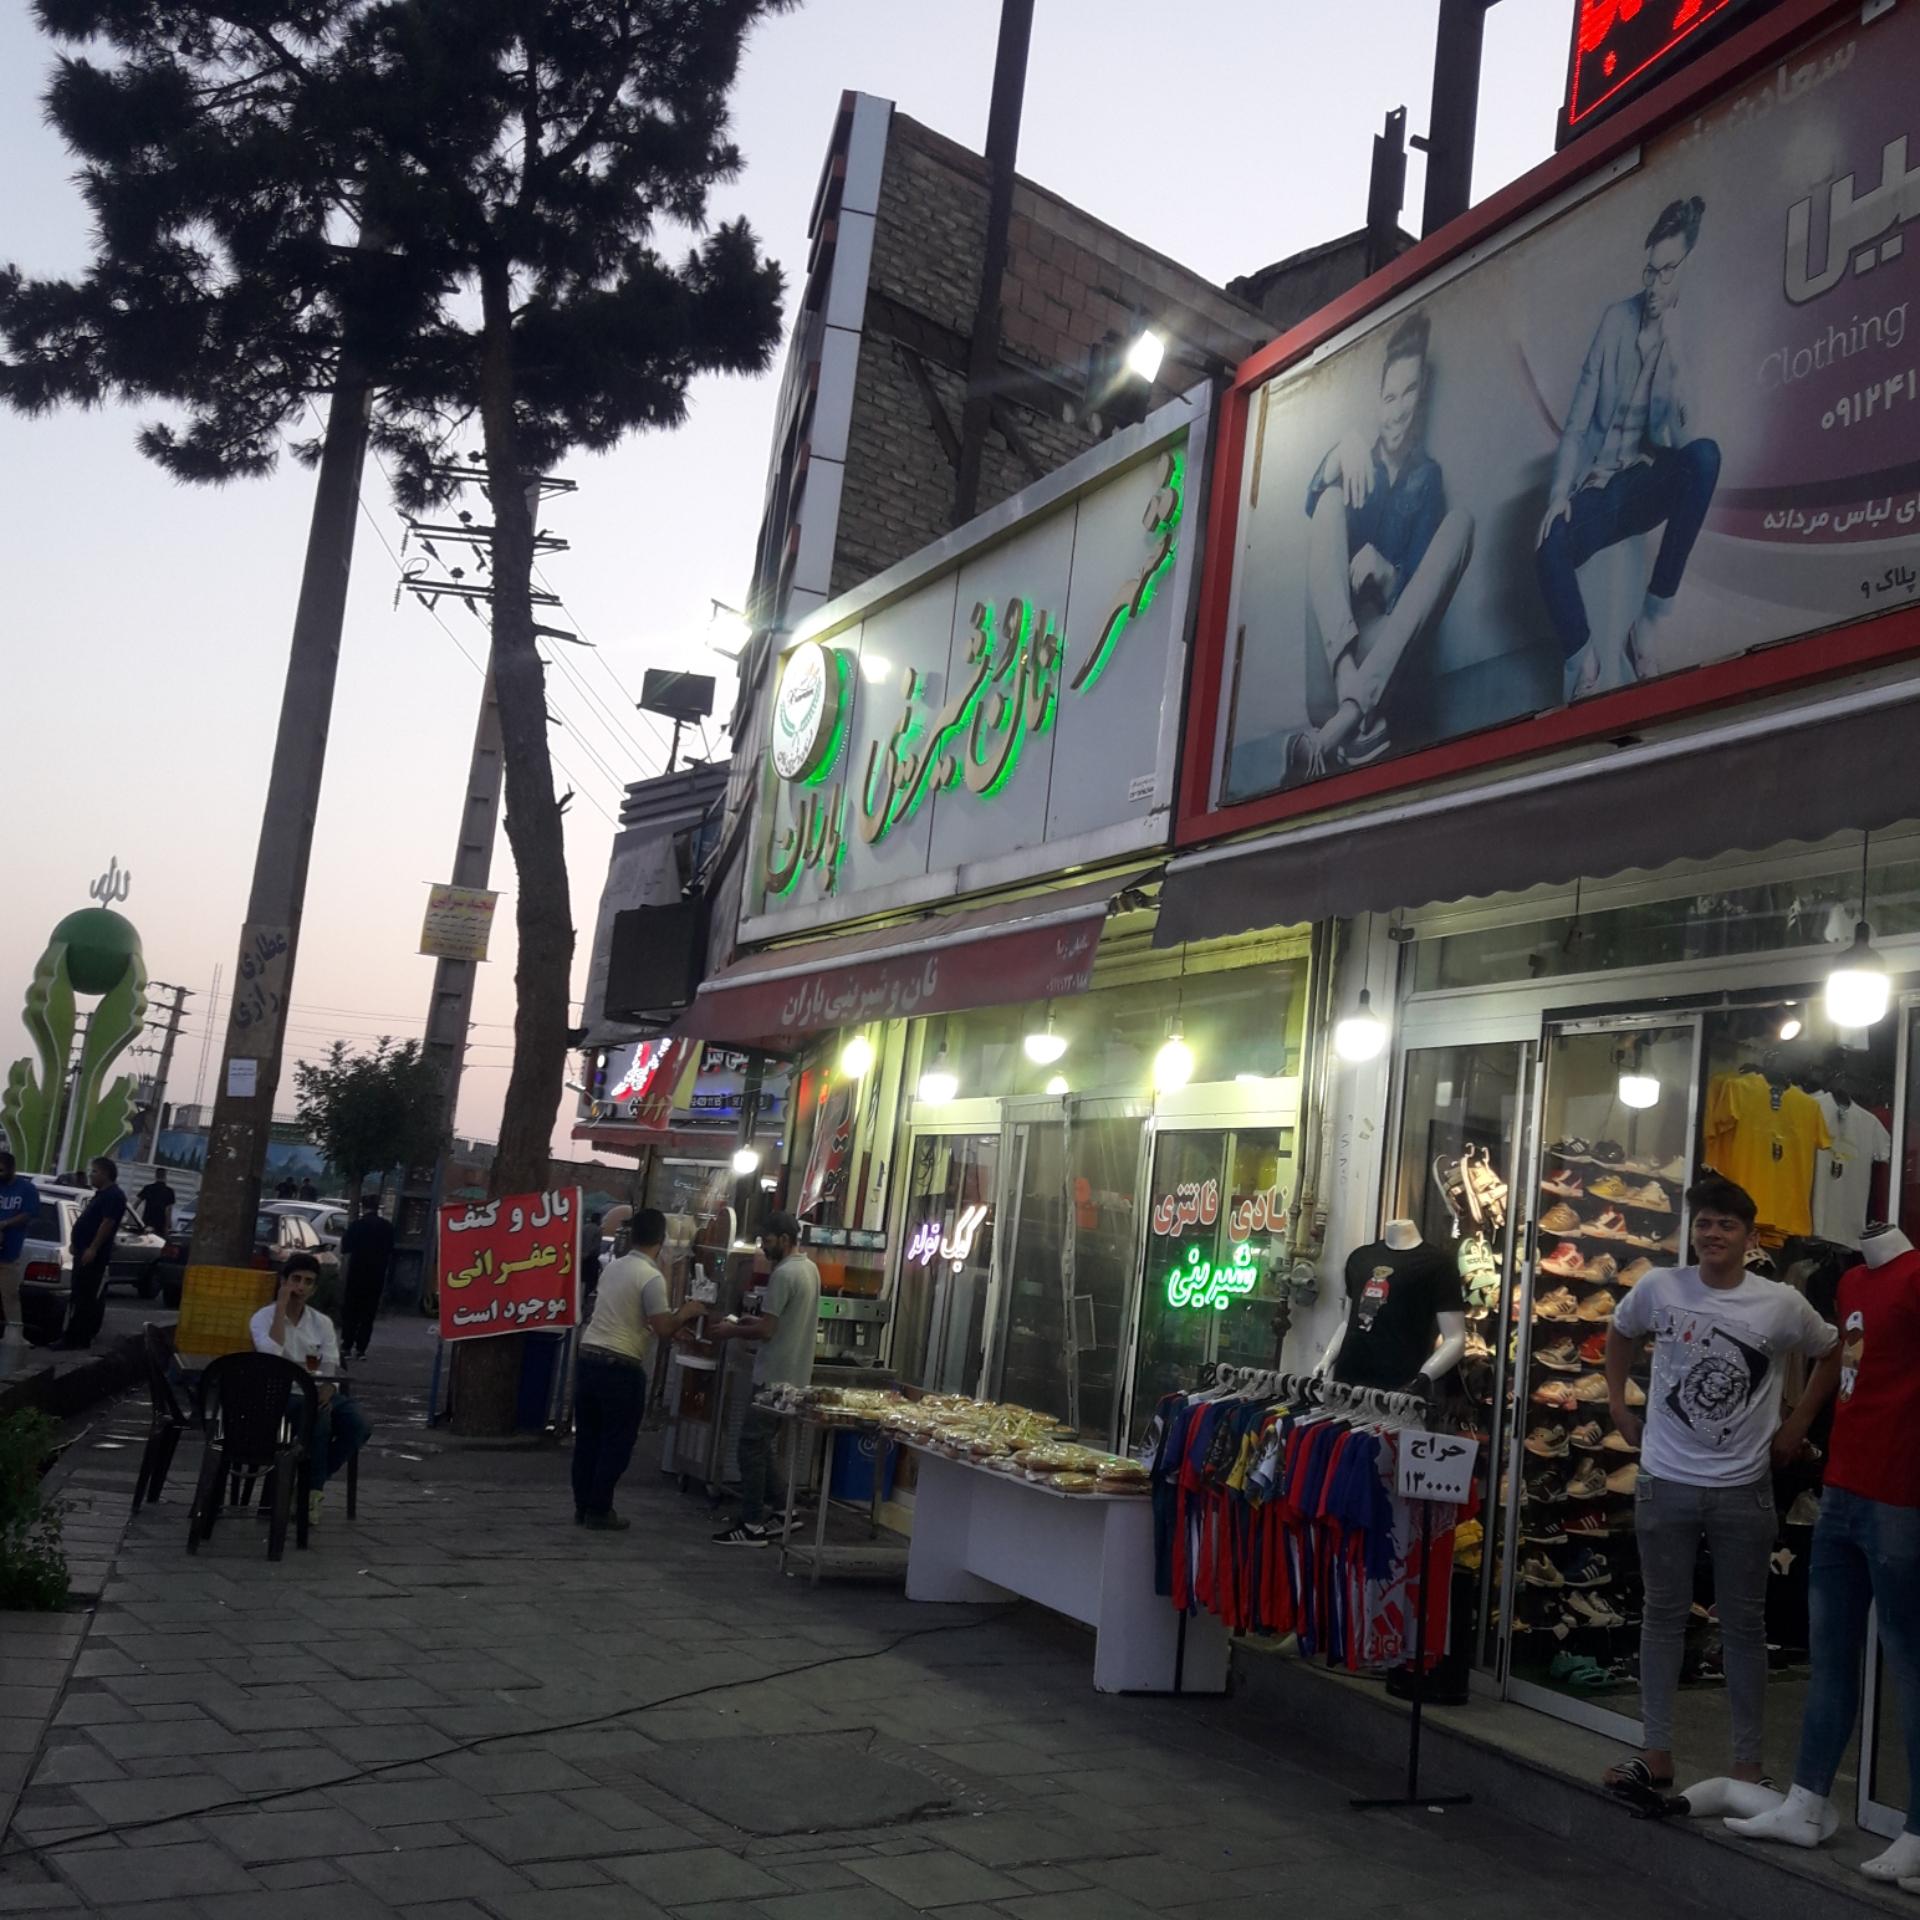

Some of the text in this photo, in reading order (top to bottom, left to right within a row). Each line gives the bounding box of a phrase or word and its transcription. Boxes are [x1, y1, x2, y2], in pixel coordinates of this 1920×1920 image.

[1757, 302, 1909, 388] Clothing
[1763, 508, 1830, 535] مردانه
[1833, 496, 1893, 532] لباس
[1861, 566, 1917, 599] پلاک ۹
[241, 931, 288, 980] عطاری
[781, 956, 939, 1026] نان و شیرینی باران
[447, 1189, 570, 1232] بال و کتف
[1153, 1178, 1290, 1243] نادی فانتزی
[907, 1205, 988, 1273] کیک تولد
[446, 1241, 572, 1288] زعفرانی
[1167, 1243, 1257, 1310] شیرینی
[453, 1297, 568, 1326] موجود است
[1411, 1436, 1467, 1462] حراج
[1406, 1470, 1461, 1494] ۱۳۰۰۰۰
